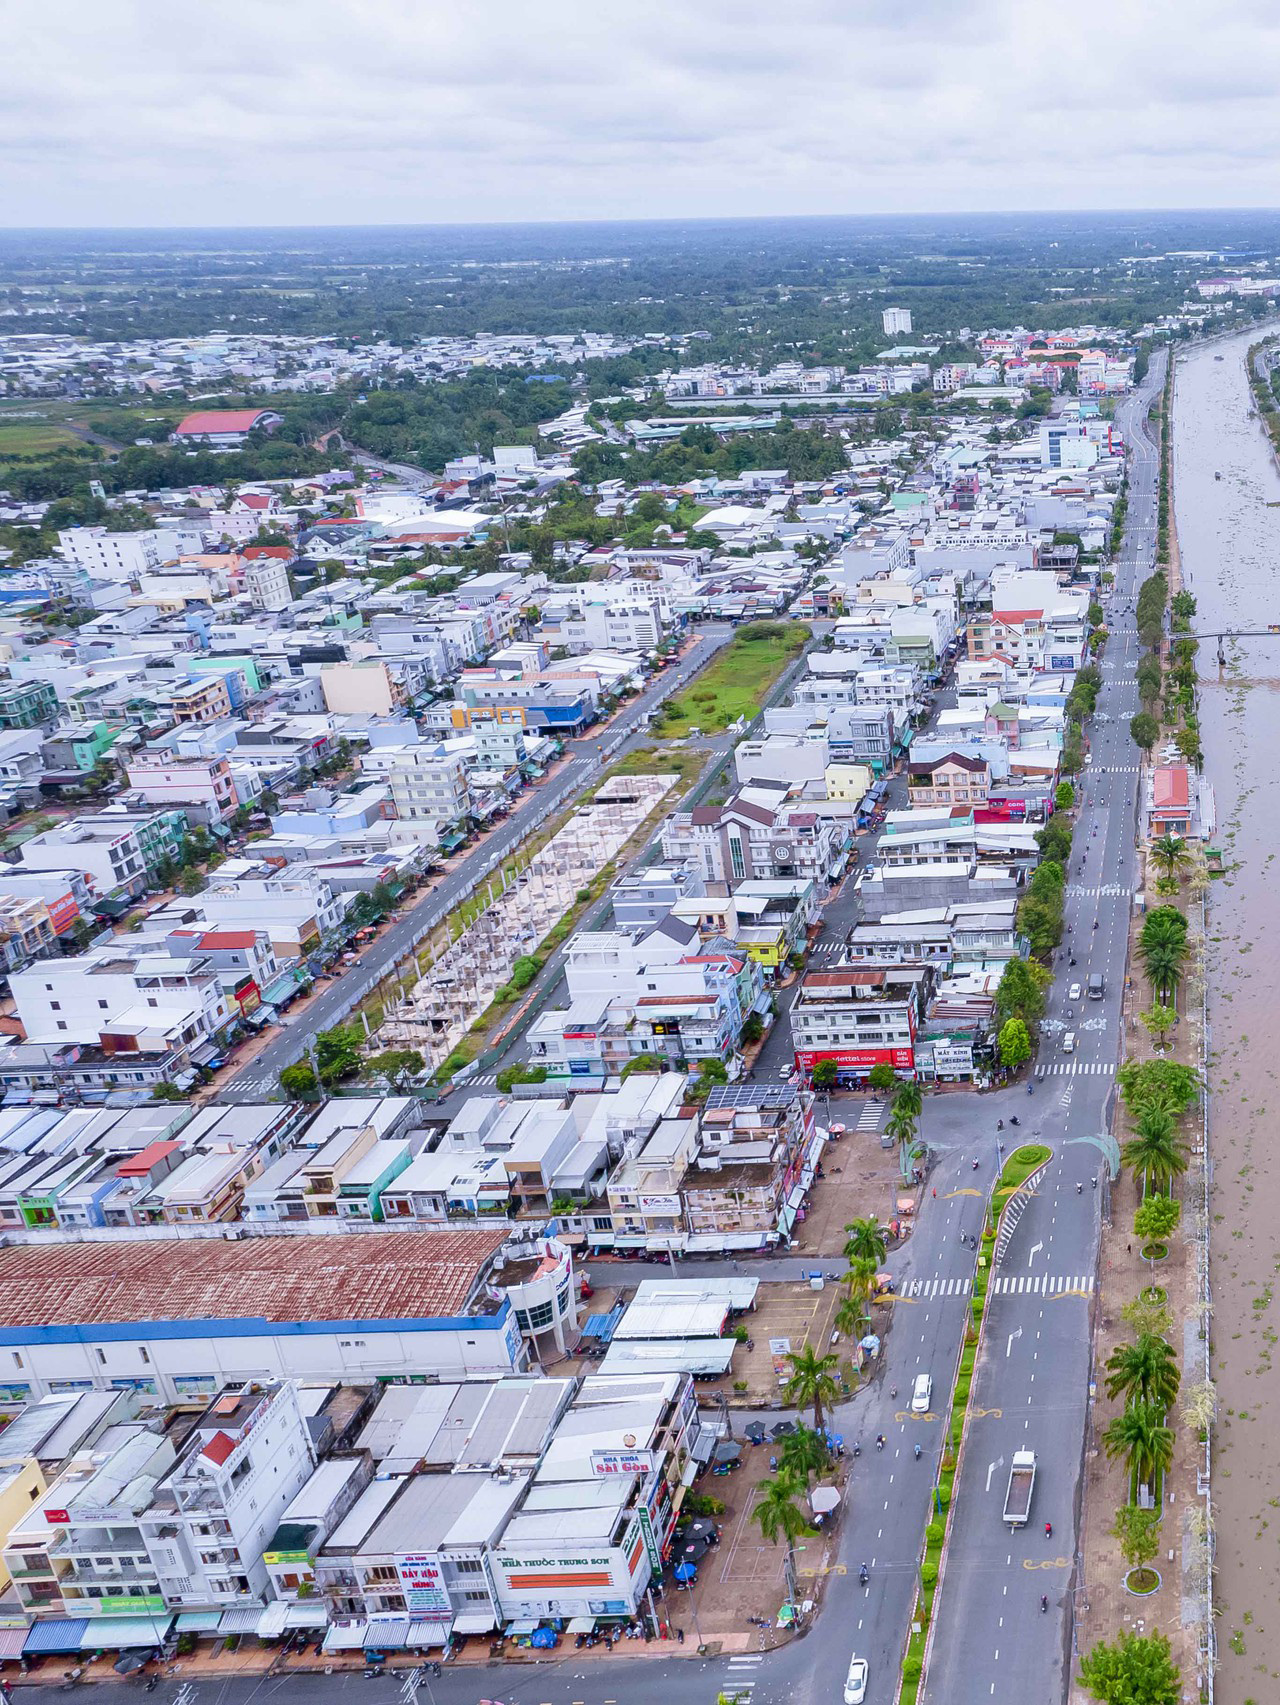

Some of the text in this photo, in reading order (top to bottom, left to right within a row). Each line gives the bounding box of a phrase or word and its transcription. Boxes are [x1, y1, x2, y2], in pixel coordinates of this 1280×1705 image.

[596, 1462, 649, 1473] Sài Gòn
[502, 1558, 522, 1567] NHÀ
[558, 1558, 588, 1566] TRUNG
